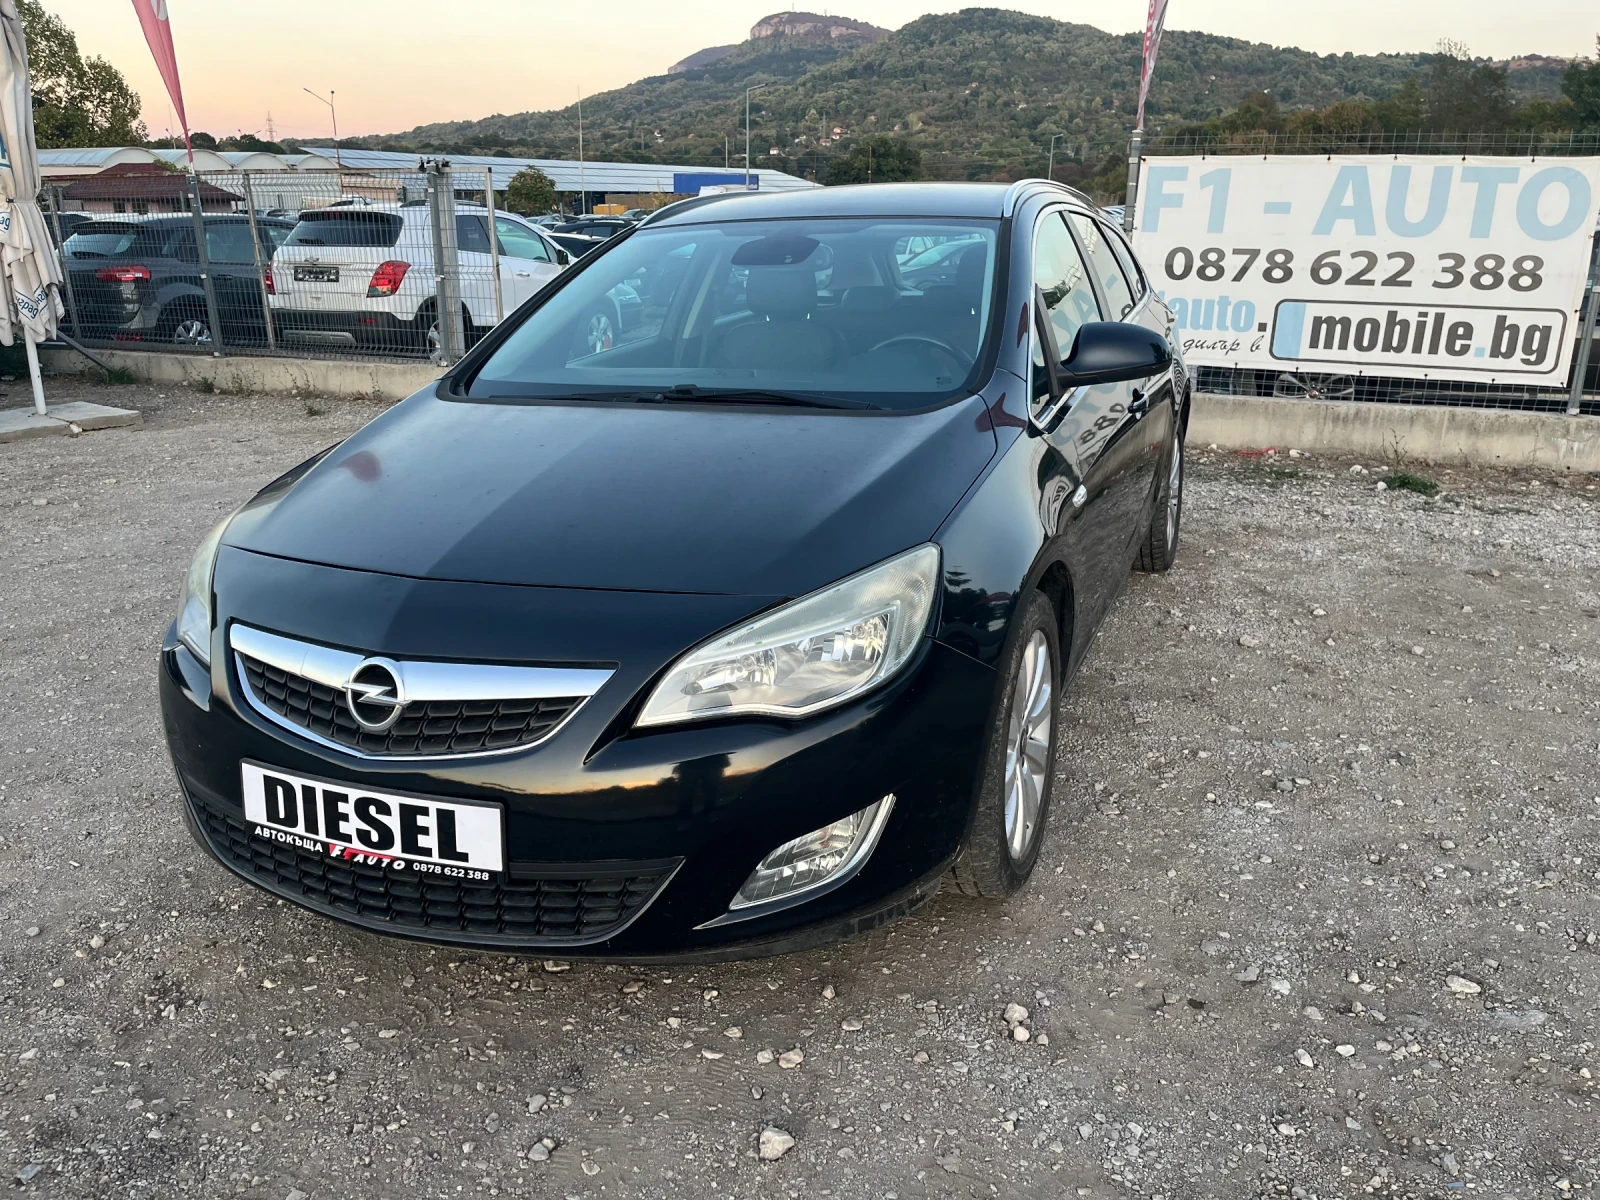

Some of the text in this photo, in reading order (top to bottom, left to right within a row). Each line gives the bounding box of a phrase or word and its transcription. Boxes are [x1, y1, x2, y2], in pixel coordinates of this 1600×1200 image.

[1140, 165, 1232, 234] F1
[1312, 164, 1592, 242] AUTO
[1164, 246, 1545, 292] 0878 622 388
[1308, 310, 1553, 366] mobile.bg
[254, 825, 324, 853] АВТОКЪЩА
[263, 774, 470, 864] DIESEL
[353, 853, 406, 870] AUTO
[412, 862, 442, 874] 0878
[444, 867, 465, 878] 622
[467, 870, 490, 881] 388
